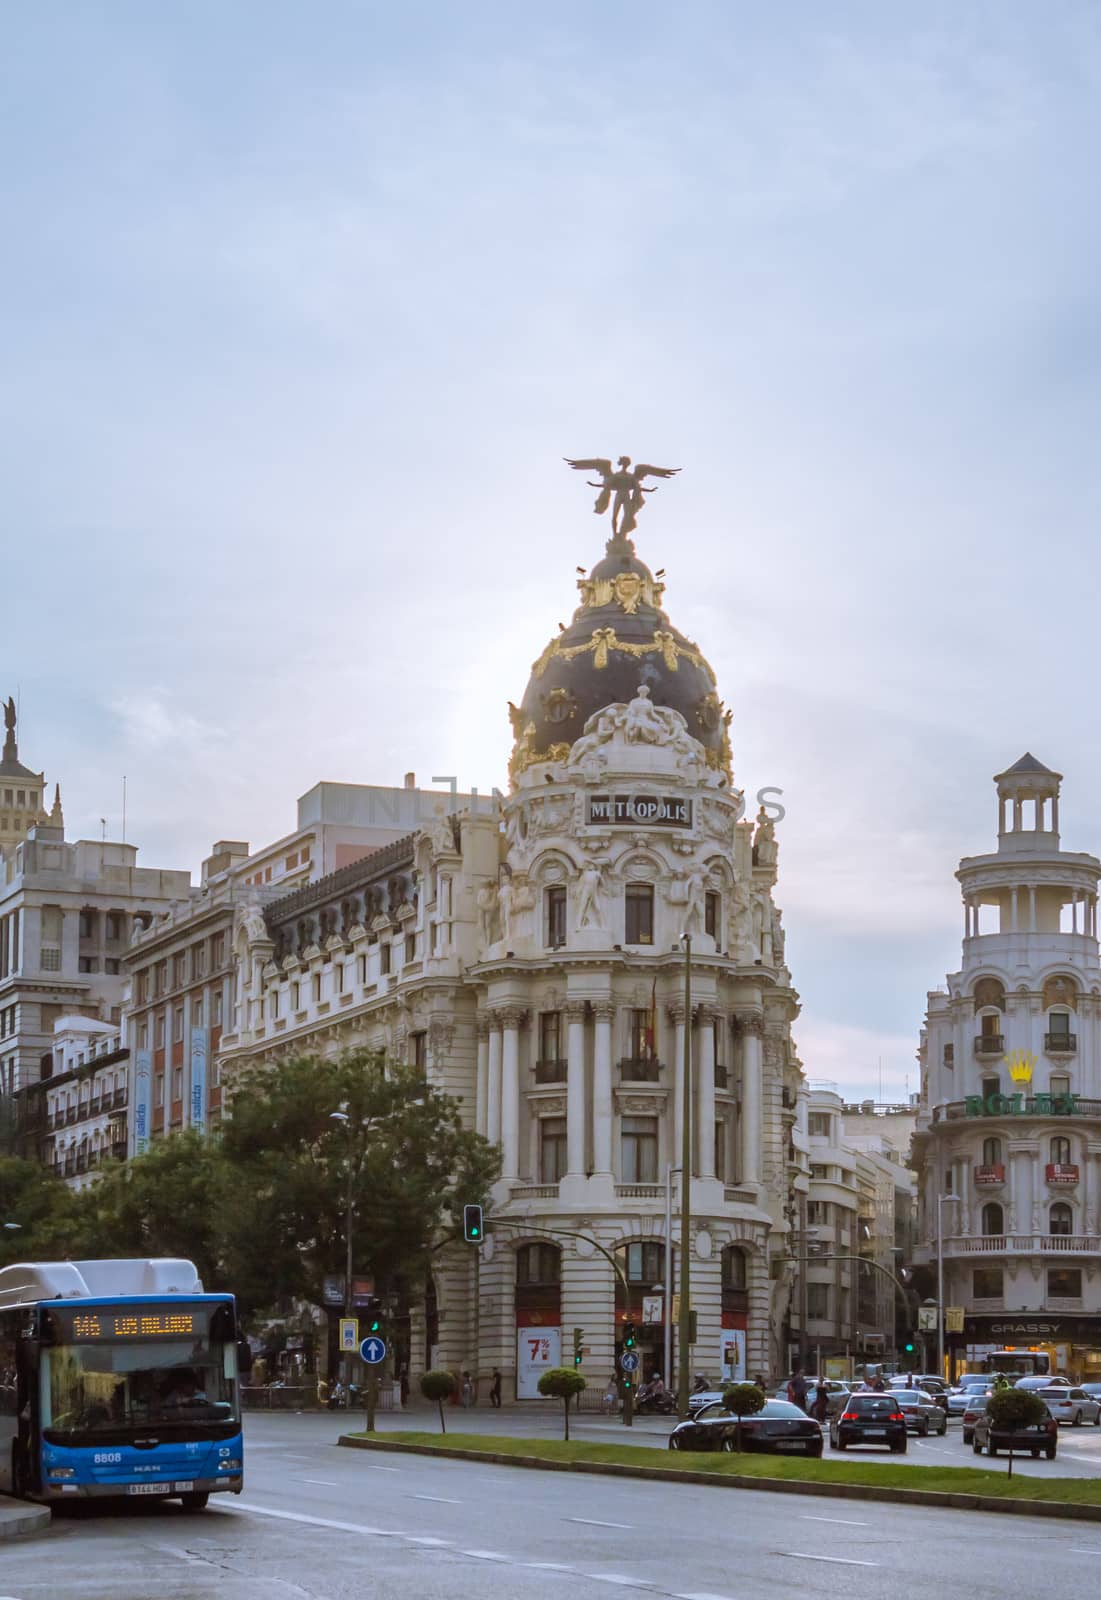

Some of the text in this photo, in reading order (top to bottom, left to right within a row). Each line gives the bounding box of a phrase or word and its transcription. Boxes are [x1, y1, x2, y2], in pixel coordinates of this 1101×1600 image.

[591, 802, 687, 820] METROPOLIS
[964, 1093, 1080, 1115] ROLEX
[991, 1324, 1061, 1333] GRASSY
[94, 1453, 121, 1464] 8808
